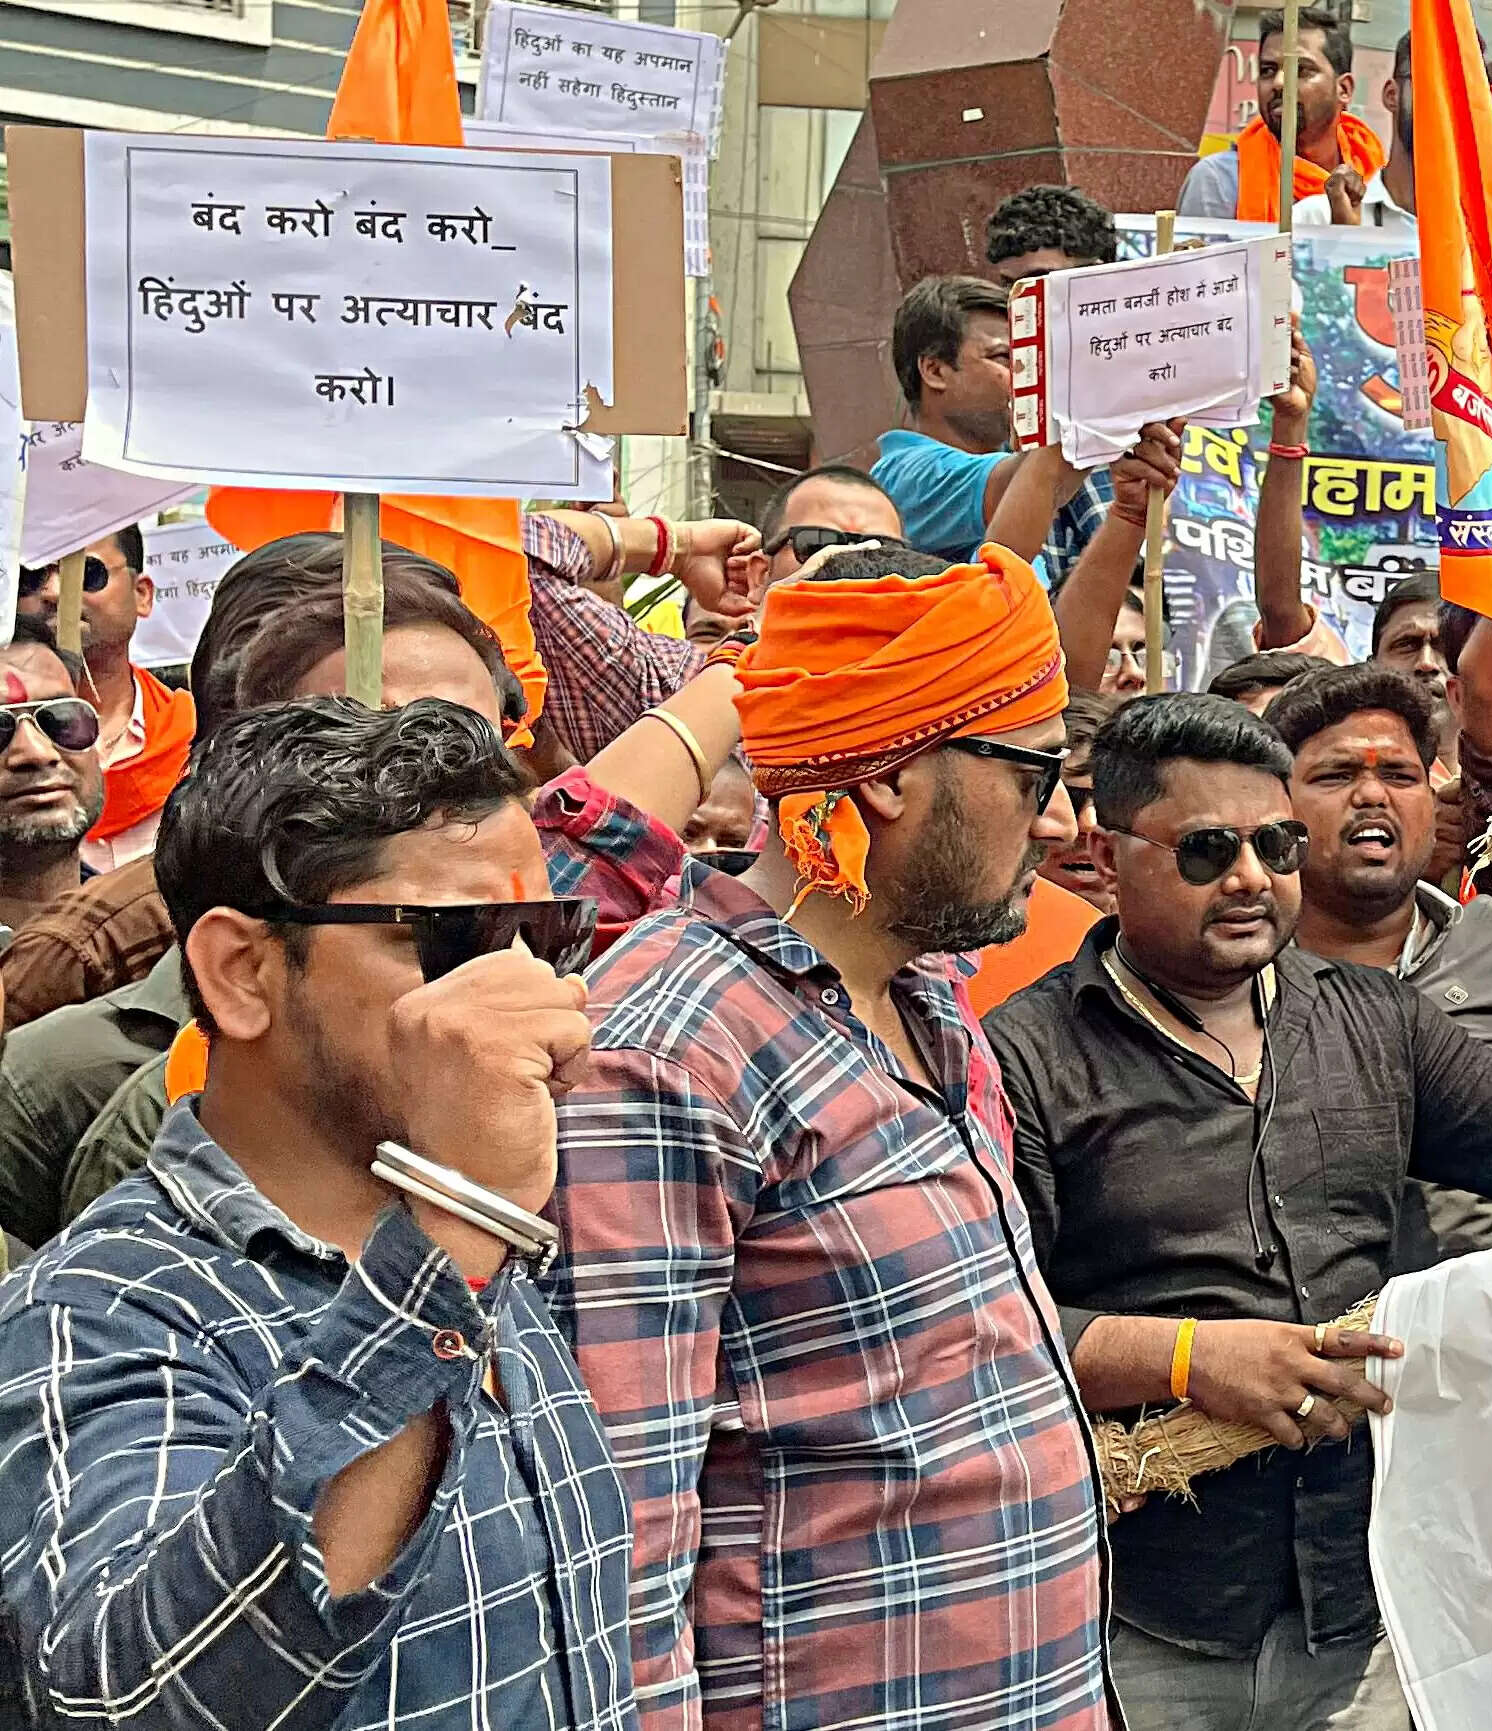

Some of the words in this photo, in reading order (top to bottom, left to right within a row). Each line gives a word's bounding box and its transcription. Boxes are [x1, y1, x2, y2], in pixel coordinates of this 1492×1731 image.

[514, 27, 564, 57] हिंदुओं
[571, 41, 593, 57] का
[601, 46, 627, 65] यह
[634, 51, 694, 73] अपमान
[518, 70, 550, 91] नहीं
[558, 77, 602, 98] सहेगा
[610, 82, 681, 111] हिंदुस्तान
[190, 191, 246, 236] बंद
[264, 198, 335, 239] करो
[353, 199, 408, 244] बंद
[137, 275, 252, 334] हिंदुओं
[271, 292, 321, 324] पर
[340, 295, 498, 331] अत्याचार
[1077, 298, 1118, 317] ममता
[1123, 286, 1161, 310] बनर्जी
[1166, 285, 1191, 307] होश
[1195, 281, 1207, 298] में
[1089, 330, 1129, 361] हिंदुओं
[1134, 331, 1153, 347] पर
[1158, 321, 1212, 344] अत्याचार
[1216, 316, 1234, 332] बंद
[314, 366, 395, 407] करो।
[1148, 362, 1177, 382] करो।
